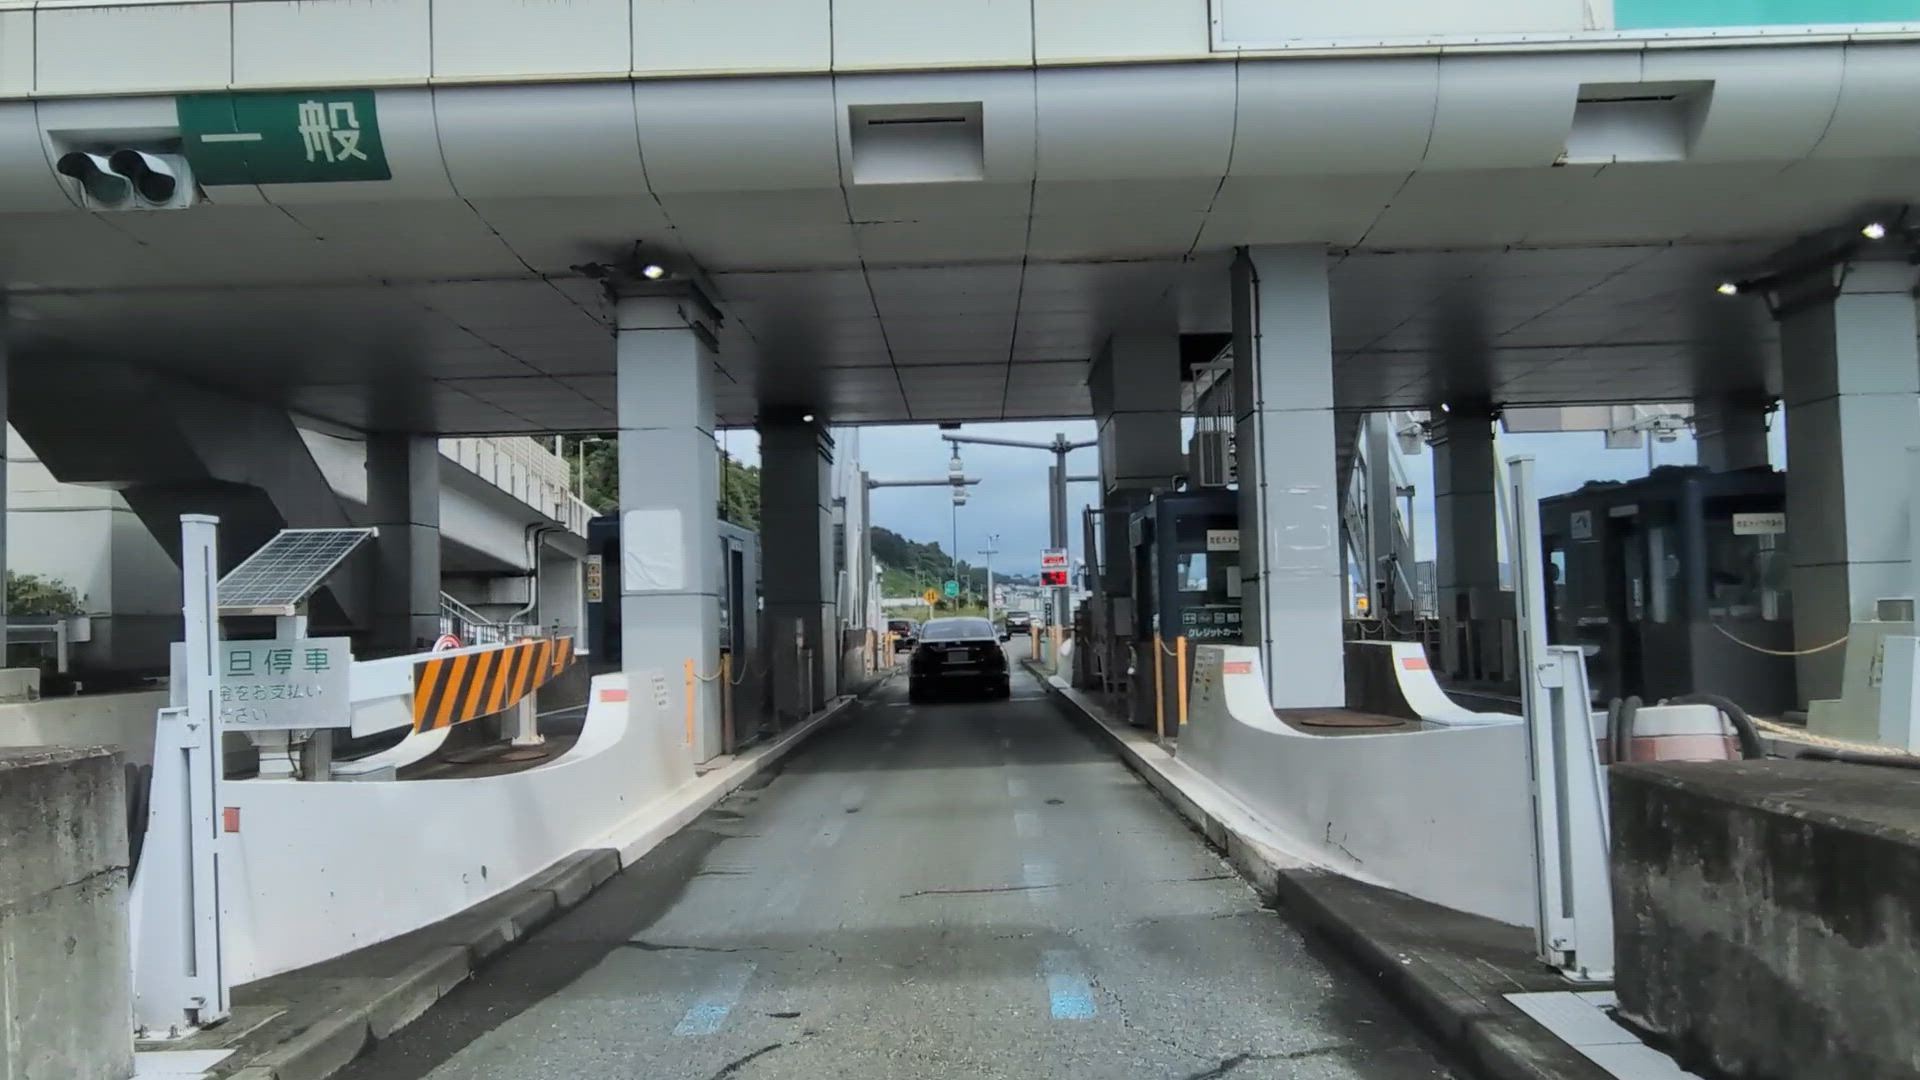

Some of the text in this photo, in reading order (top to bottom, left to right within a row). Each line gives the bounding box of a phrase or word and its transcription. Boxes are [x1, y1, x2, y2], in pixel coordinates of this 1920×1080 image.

[201, 100, 367, 163] 一般
[227, 648, 330, 676] 旦停車
